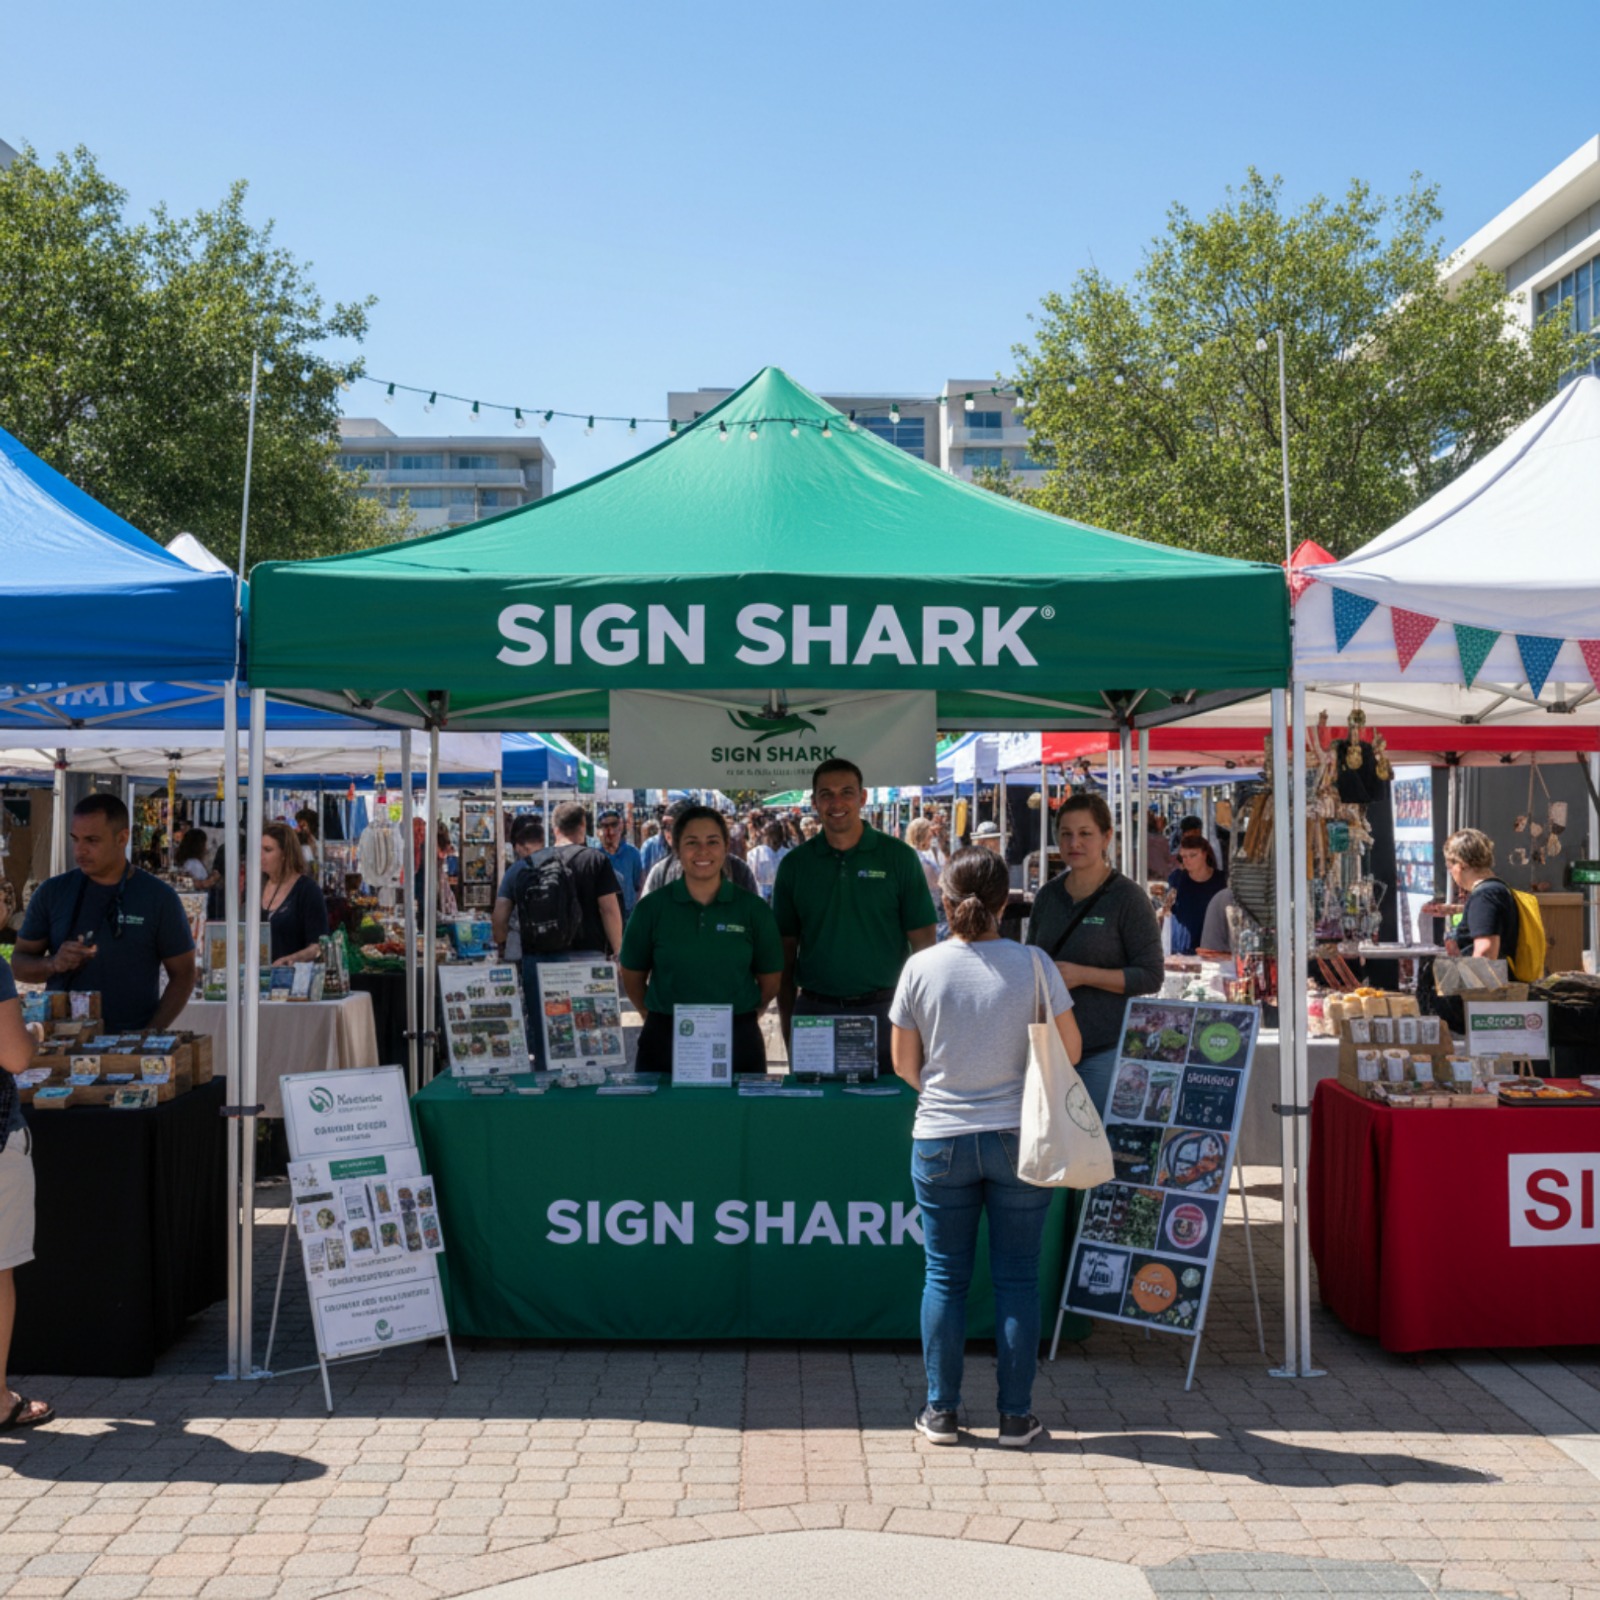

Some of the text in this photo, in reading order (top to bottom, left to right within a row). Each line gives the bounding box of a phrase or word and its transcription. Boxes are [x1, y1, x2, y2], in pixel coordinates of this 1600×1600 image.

[496, 604, 706, 667] SIGN
[711, 746, 837, 762] SIGN SHARK
[546, 1200, 925, 1245] SIGN SHARK
